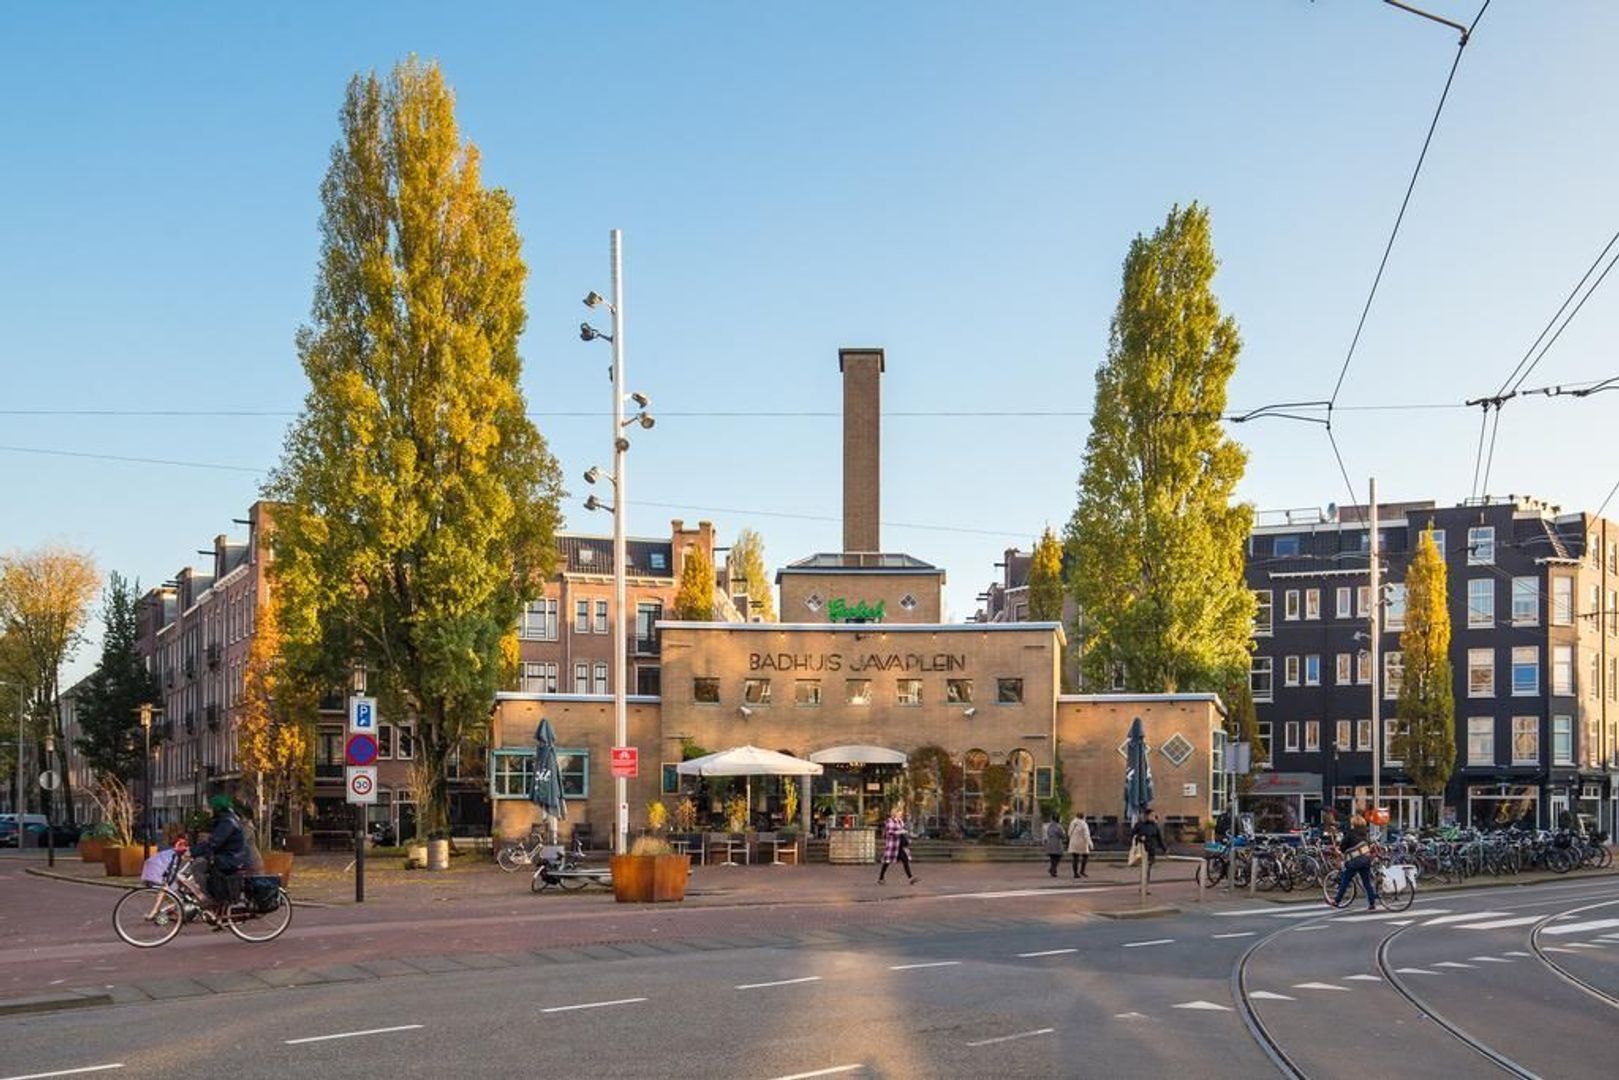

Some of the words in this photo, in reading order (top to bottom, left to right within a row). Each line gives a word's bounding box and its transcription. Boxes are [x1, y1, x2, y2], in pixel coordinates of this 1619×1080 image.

[749, 653, 842, 672] BADHUIS
[849, 653, 966, 672] JAVAPLEIN
[356, 780, 369, 789] 30
